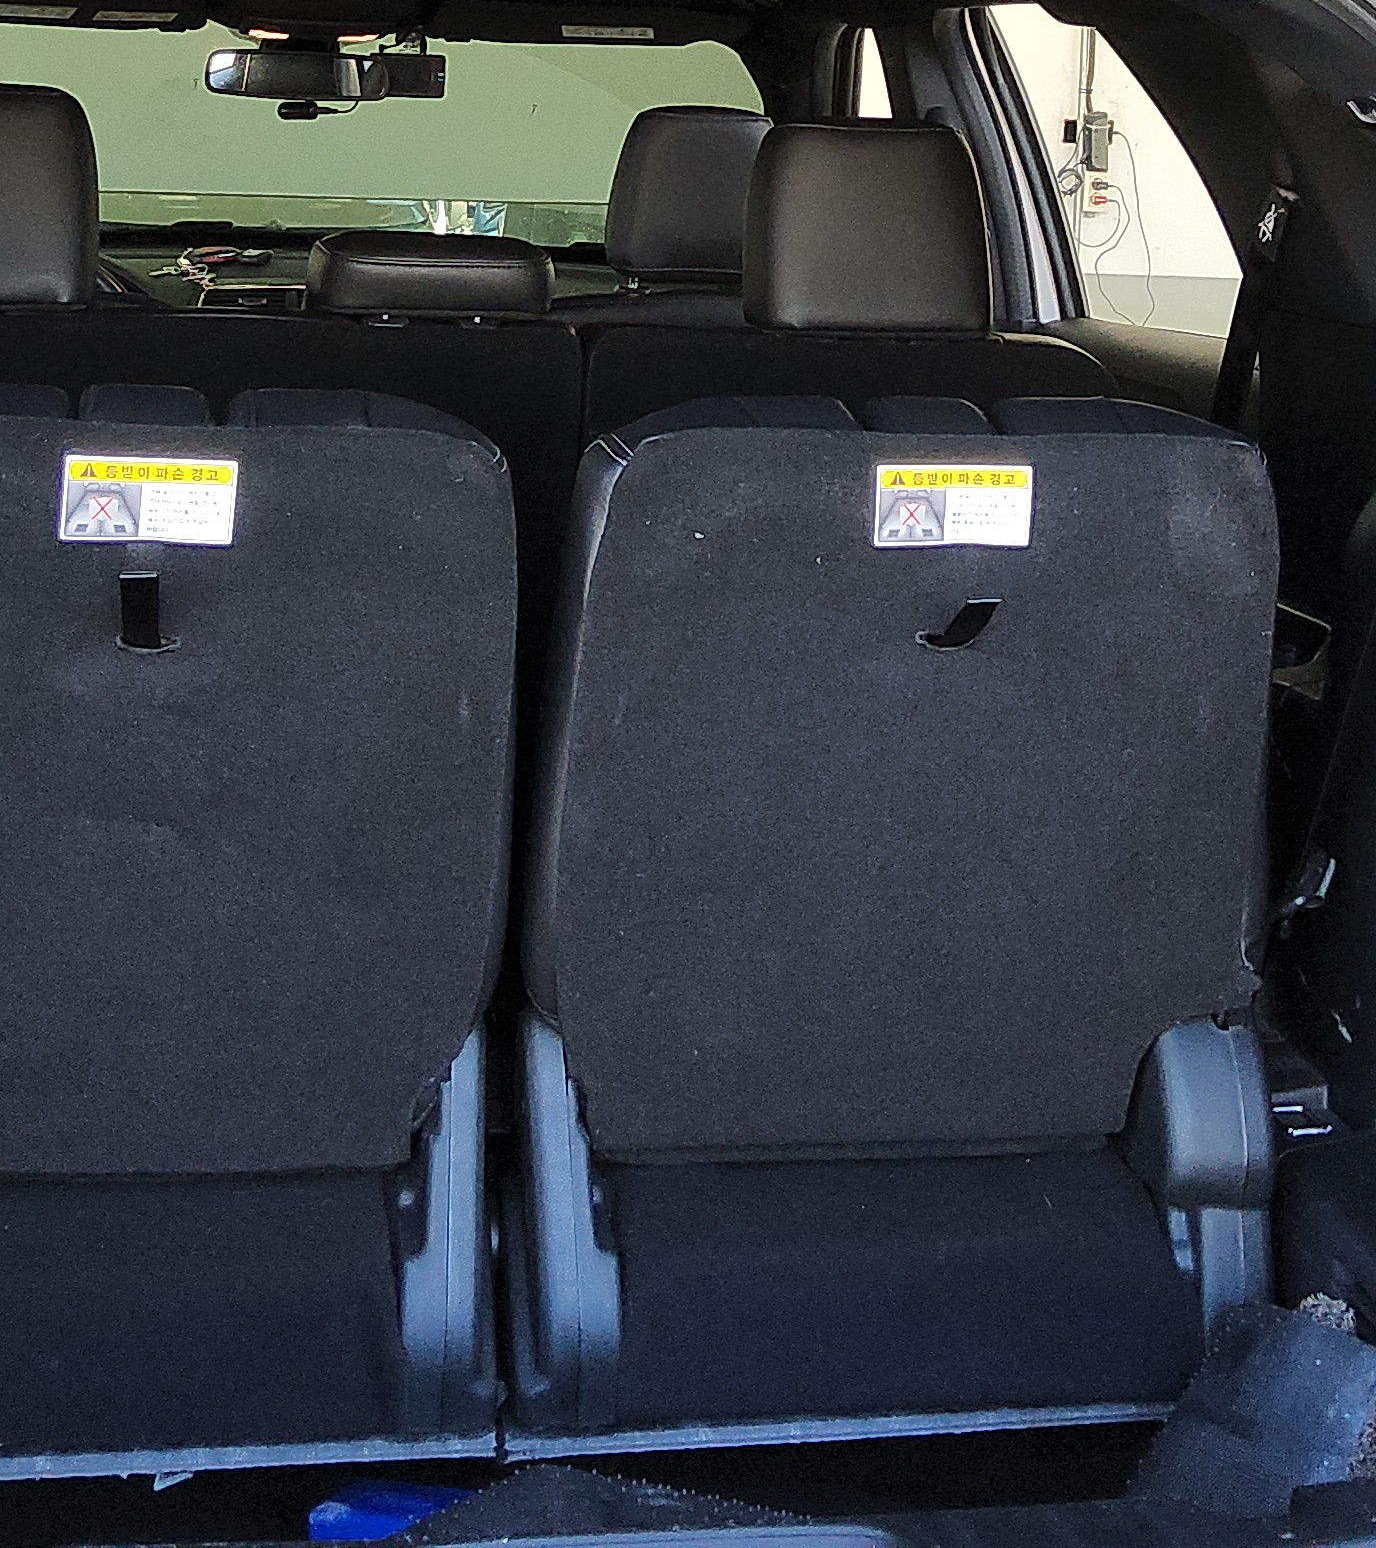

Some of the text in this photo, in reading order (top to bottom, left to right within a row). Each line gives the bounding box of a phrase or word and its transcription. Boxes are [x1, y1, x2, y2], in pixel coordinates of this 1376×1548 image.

[155, 467, 185, 481] 파손
[191, 468, 219, 482] 경고
[958, 473, 985, 486] 파손
[989, 473, 1016, 486] 경고
